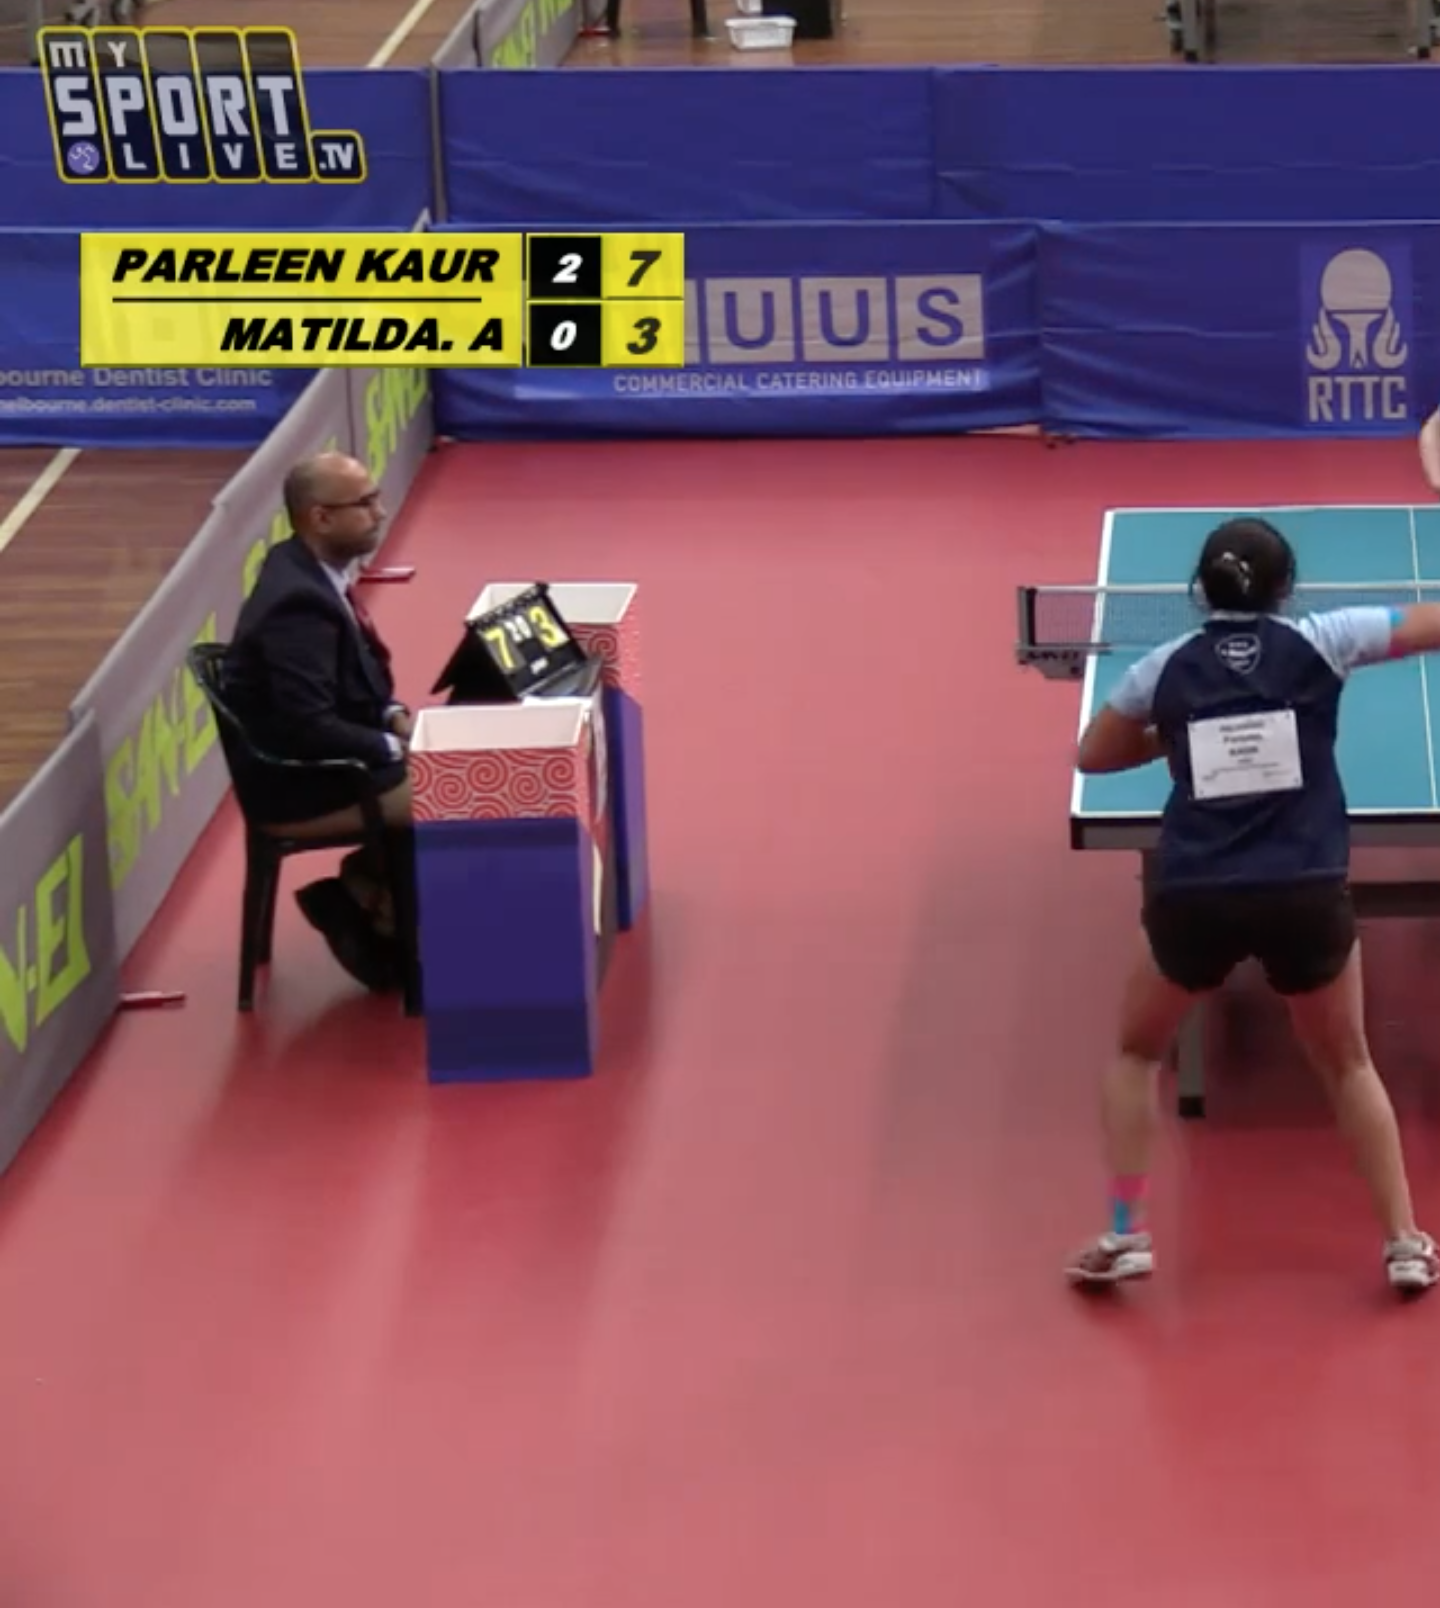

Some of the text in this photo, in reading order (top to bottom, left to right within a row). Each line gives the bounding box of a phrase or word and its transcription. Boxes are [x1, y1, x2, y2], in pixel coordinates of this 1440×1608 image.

[94, 368, 190, 388] Dentist
[197, 368, 273, 387] Clinic
[613, 369, 982, 393] COMMERCIAL CATERING EQUIPMENT
[1307, 376, 1407, 423] RTTC
[484, 627, 515, 670] 7
[528, 606, 560, 648] 3
